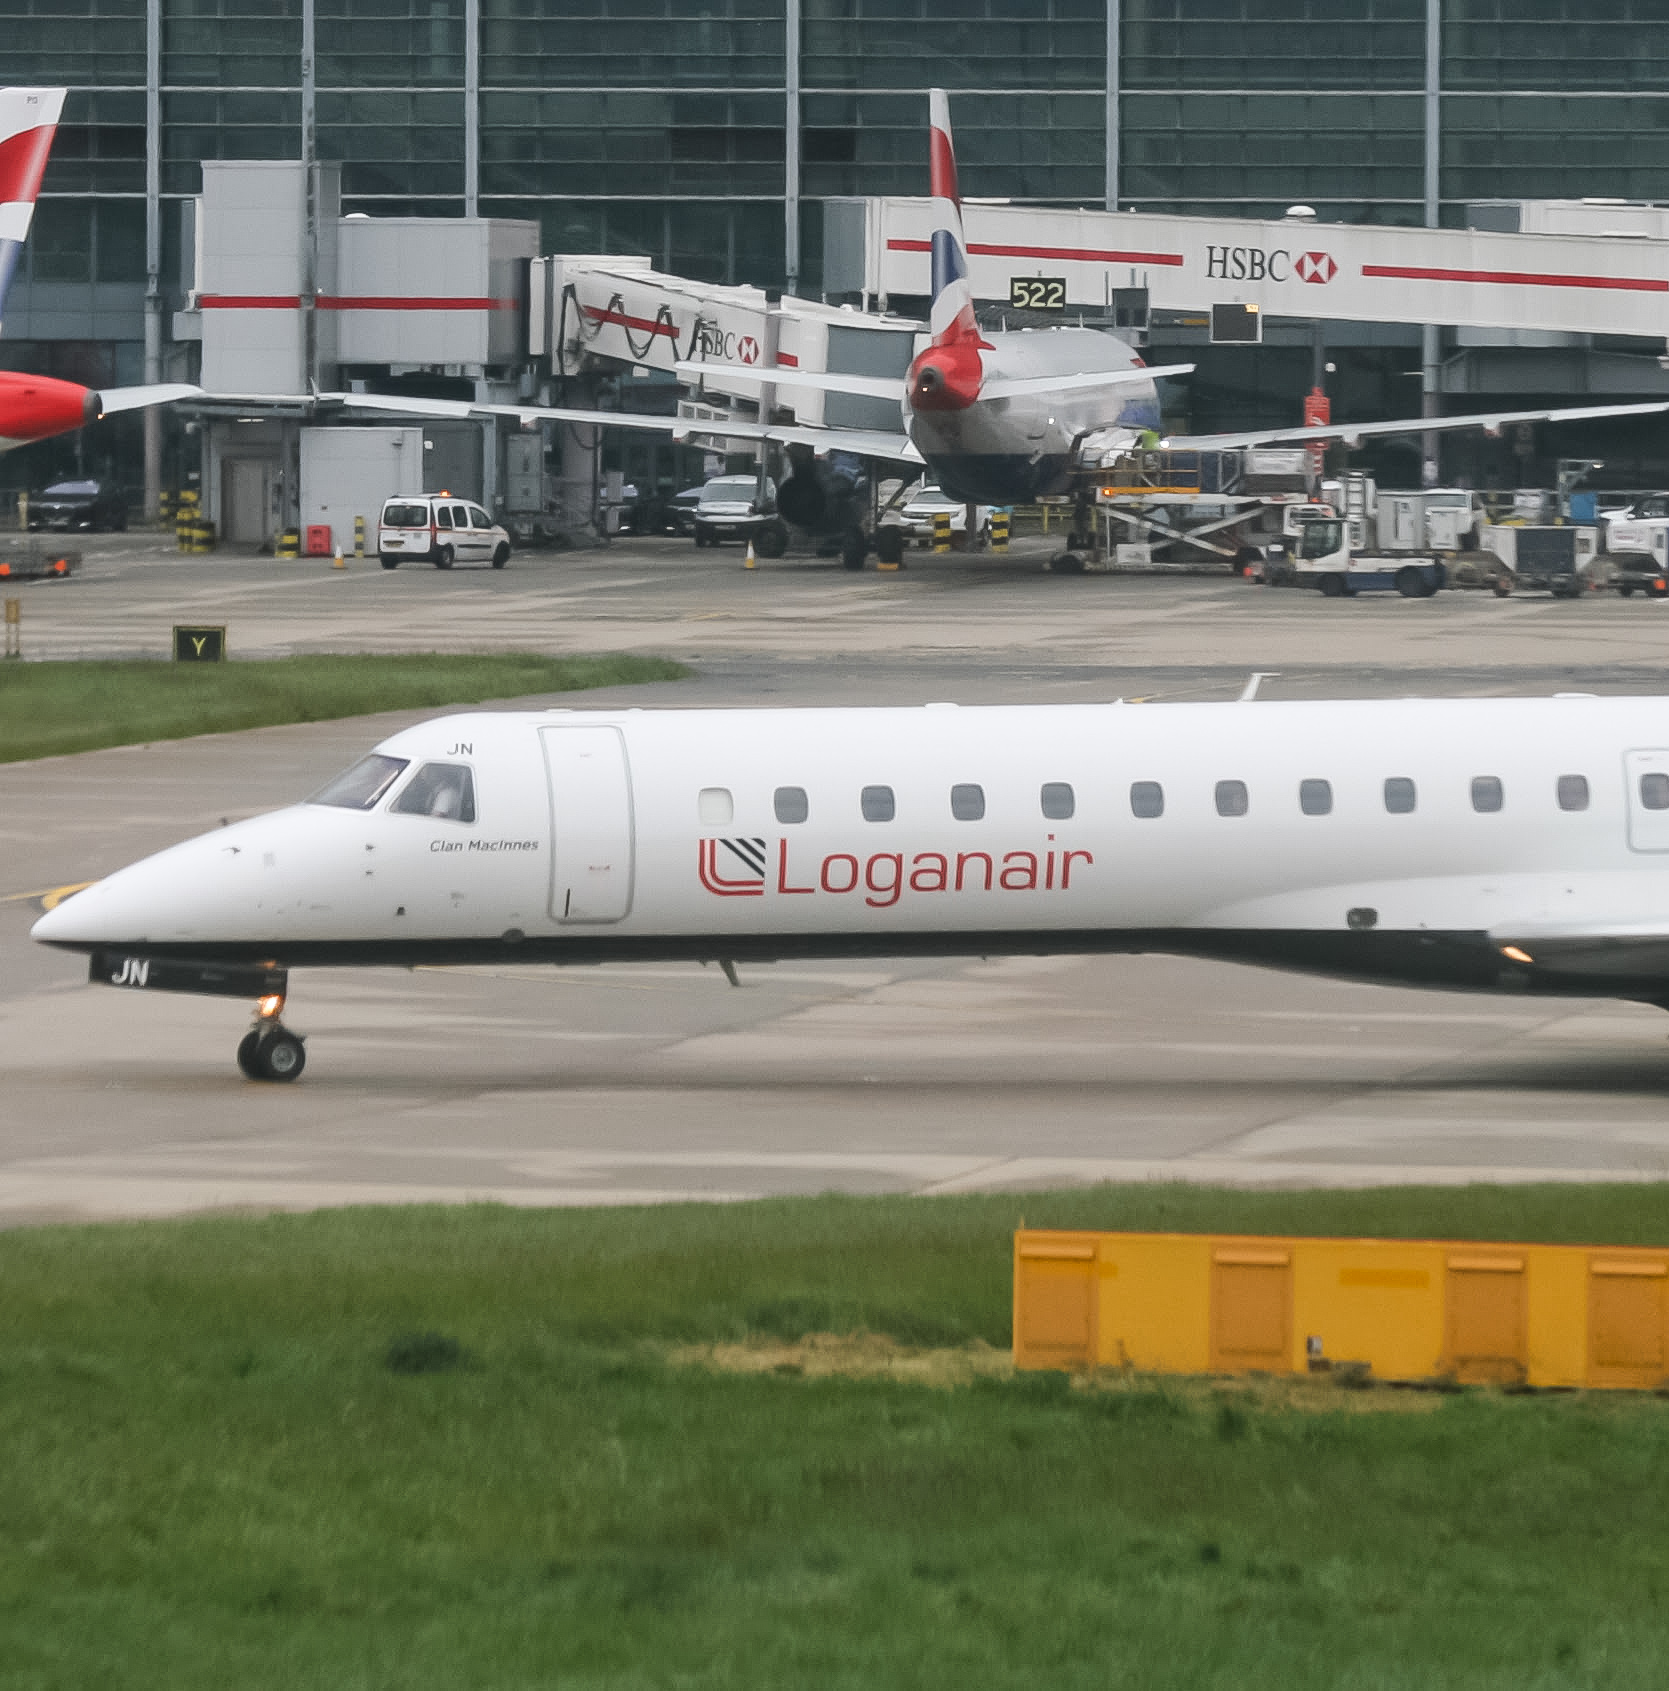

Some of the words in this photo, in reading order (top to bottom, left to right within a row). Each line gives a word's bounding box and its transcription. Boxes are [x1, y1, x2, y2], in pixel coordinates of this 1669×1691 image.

[1204, 245, 1290, 282] HSBC
[1012, 282, 1065, 308] 522
[192, 636, 207, 657] Y
[446, 742, 473, 755] JN
[430, 840, 463, 852] Clan
[468, 840, 539, 851] MacInnes
[777, 833, 1094, 908] Loganair
[111, 958, 150, 987] JN
